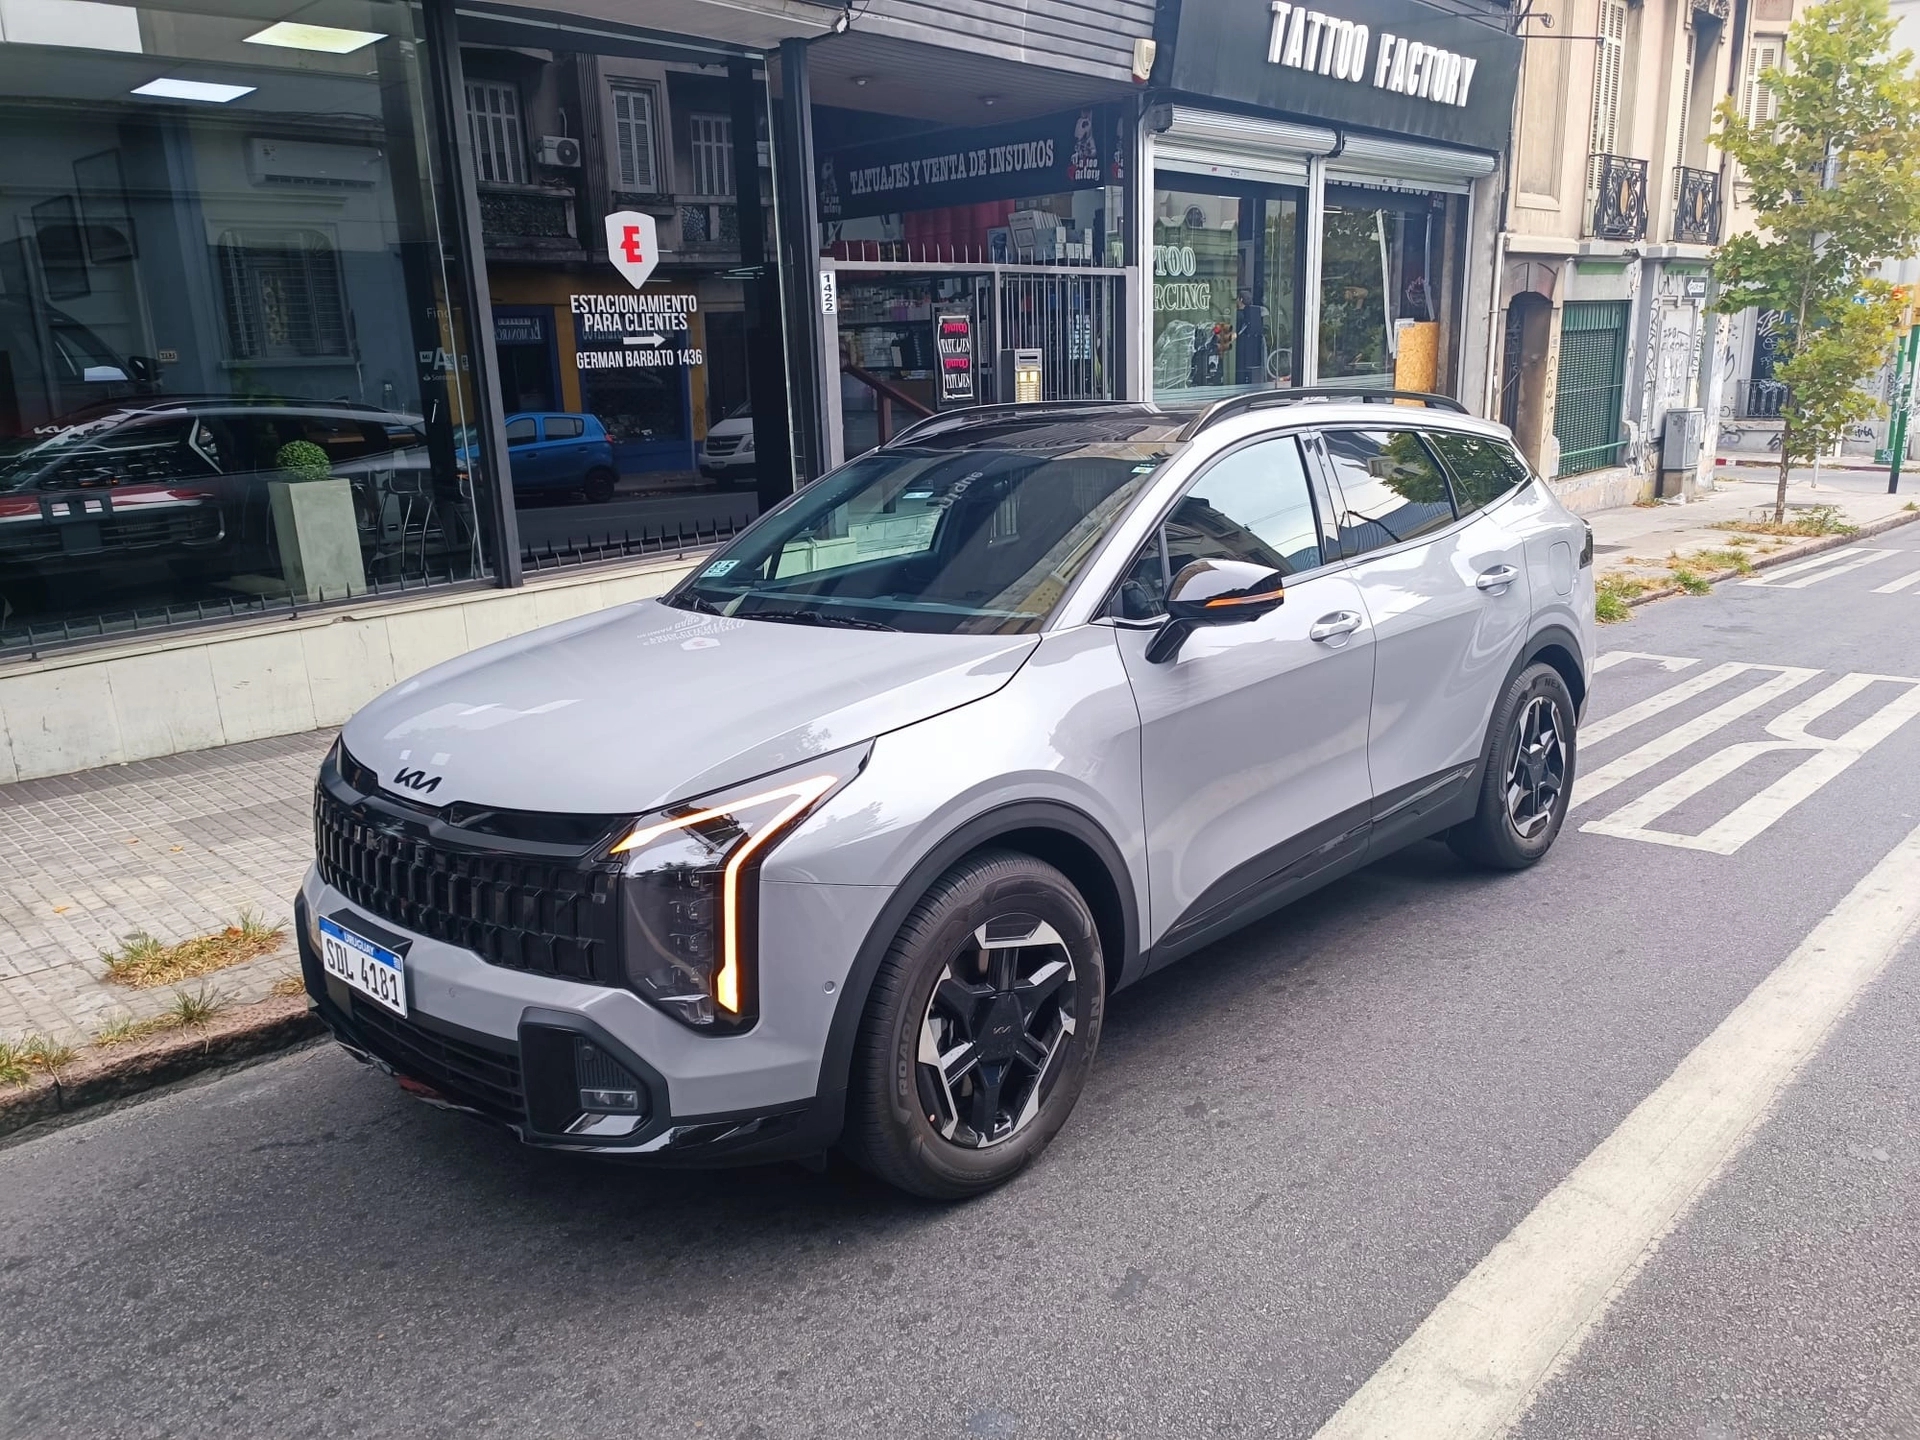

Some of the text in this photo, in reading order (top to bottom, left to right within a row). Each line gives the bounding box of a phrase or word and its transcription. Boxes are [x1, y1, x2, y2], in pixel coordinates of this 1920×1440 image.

[1268, 1, 1477, 108] TATTOO FACTORY
[850, 139, 1054, 195] TATUAJES Y VENTA DE INSUMOS
[570, 294, 698, 314] ESTACIONAMIENTO
[823, 274, 834, 312] 1422
[584, 313, 622, 332] PARA
[625, 312, 688, 331] CLIENTES
[576, 348, 703, 369] GERMAN BARBATO 1436
[393, 767, 442, 794] KIA
[326, 938, 400, 1008] SDL 4181
